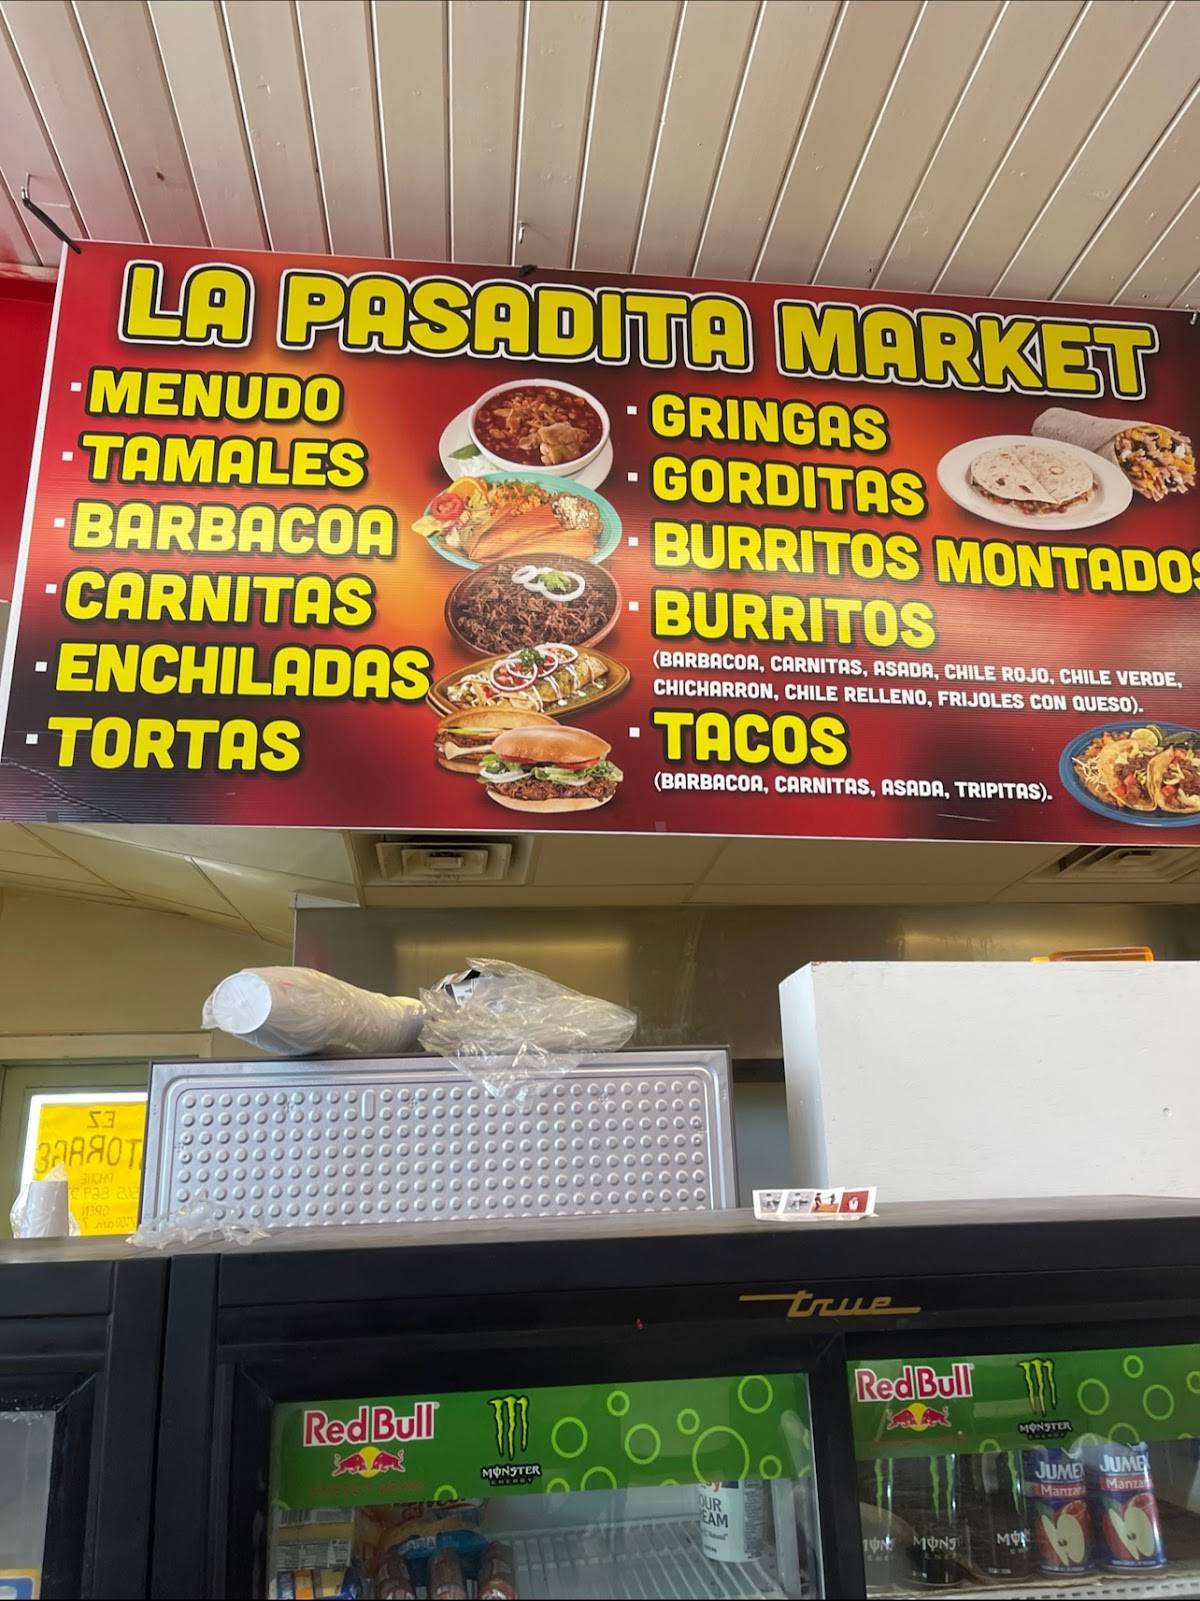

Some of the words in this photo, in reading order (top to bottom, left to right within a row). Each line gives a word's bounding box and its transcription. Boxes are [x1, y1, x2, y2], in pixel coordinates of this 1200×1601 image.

[120, 262, 251, 344] LA
[281, 270, 751, 370] PASADITA
[778, 302, 1155, 397] MARKET
[87, 368, 343, 422] MENUDO
[650, 393, 888, 452] GRINGAS
[80, 434, 366, 487] TAMALES
[651, 456, 926, 517] GORDITAS
[72, 502, 395, 557] BARBACOA
[653, 521, 921, 582] BURRITOS
[935, 538, 1200, 595] MONTADO
[64, 570, 374, 627] CARNITAS
[654, 589, 937, 650] BURRITOS
[54, 642, 431, 702] ENCHILADAS
[653, 649, 765, 673] (BARBACOA,
[770, 656, 868, 677] CARNITAS,
[873, 660, 939, 681] ASADA,
[944, 663, 996, 682] CHILE
[1002, 665, 1055, 686] ROJO,
[1059, 669, 1112, 686] CHILE
[1116, 670, 1183, 689] VERDE,
[653, 678, 779, 702] CHICHARRON,
[784, 683, 838, 702] CHILE
[844, 686, 932, 708] RELLENO,
[938, 690, 1025, 710] FRIJOLES
[1029, 694, 1067, 711] CON
[1072, 695, 1145, 715] QUESO).
[46, 715, 302, 771] TORTAS
[652, 710, 849, 767] TACOS
[653, 771, 769, 794] (BARBACOA,
[774, 775, 876, 798] CARNITAS,
[881, 778, 950, 799] ASADA,
[954, 780, 1053, 802] TRIPITAS).
[739, 1290, 921, 1318] true
